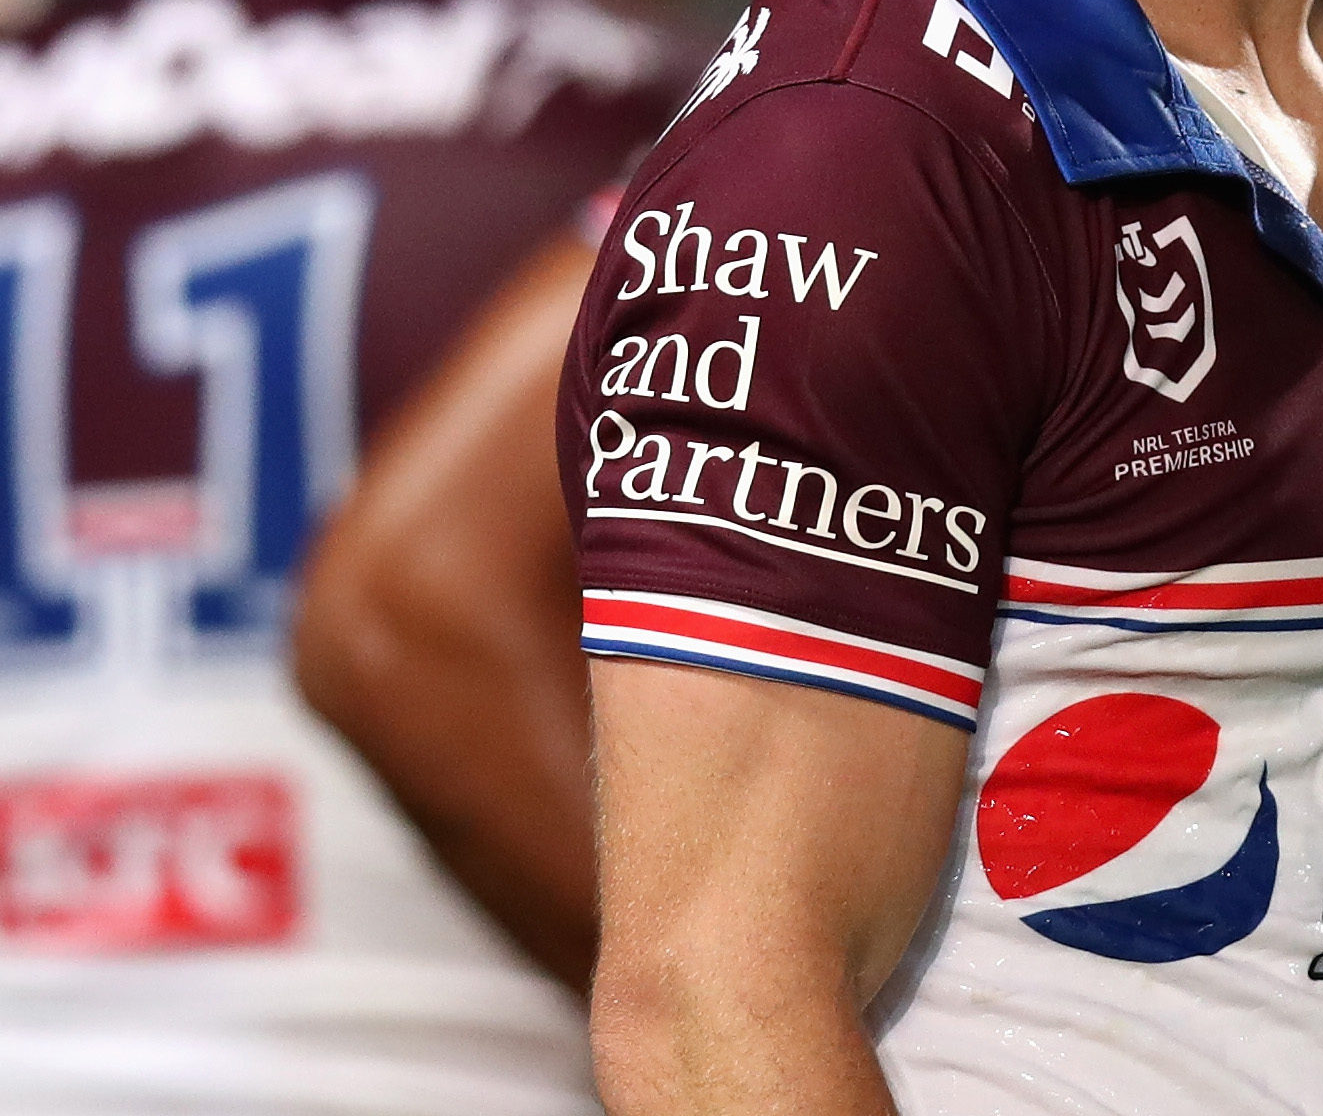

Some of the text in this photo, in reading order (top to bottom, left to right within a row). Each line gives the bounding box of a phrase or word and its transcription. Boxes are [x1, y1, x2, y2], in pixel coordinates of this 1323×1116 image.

[616, 201, 878, 311] Shaw
[601, 316, 761, 412] and
[1114, 437, 1255, 481] PREMIERSHIP
[1132, 419, 1237, 455] NRL TELSTRA
[586, 409, 988, 574] Partners
